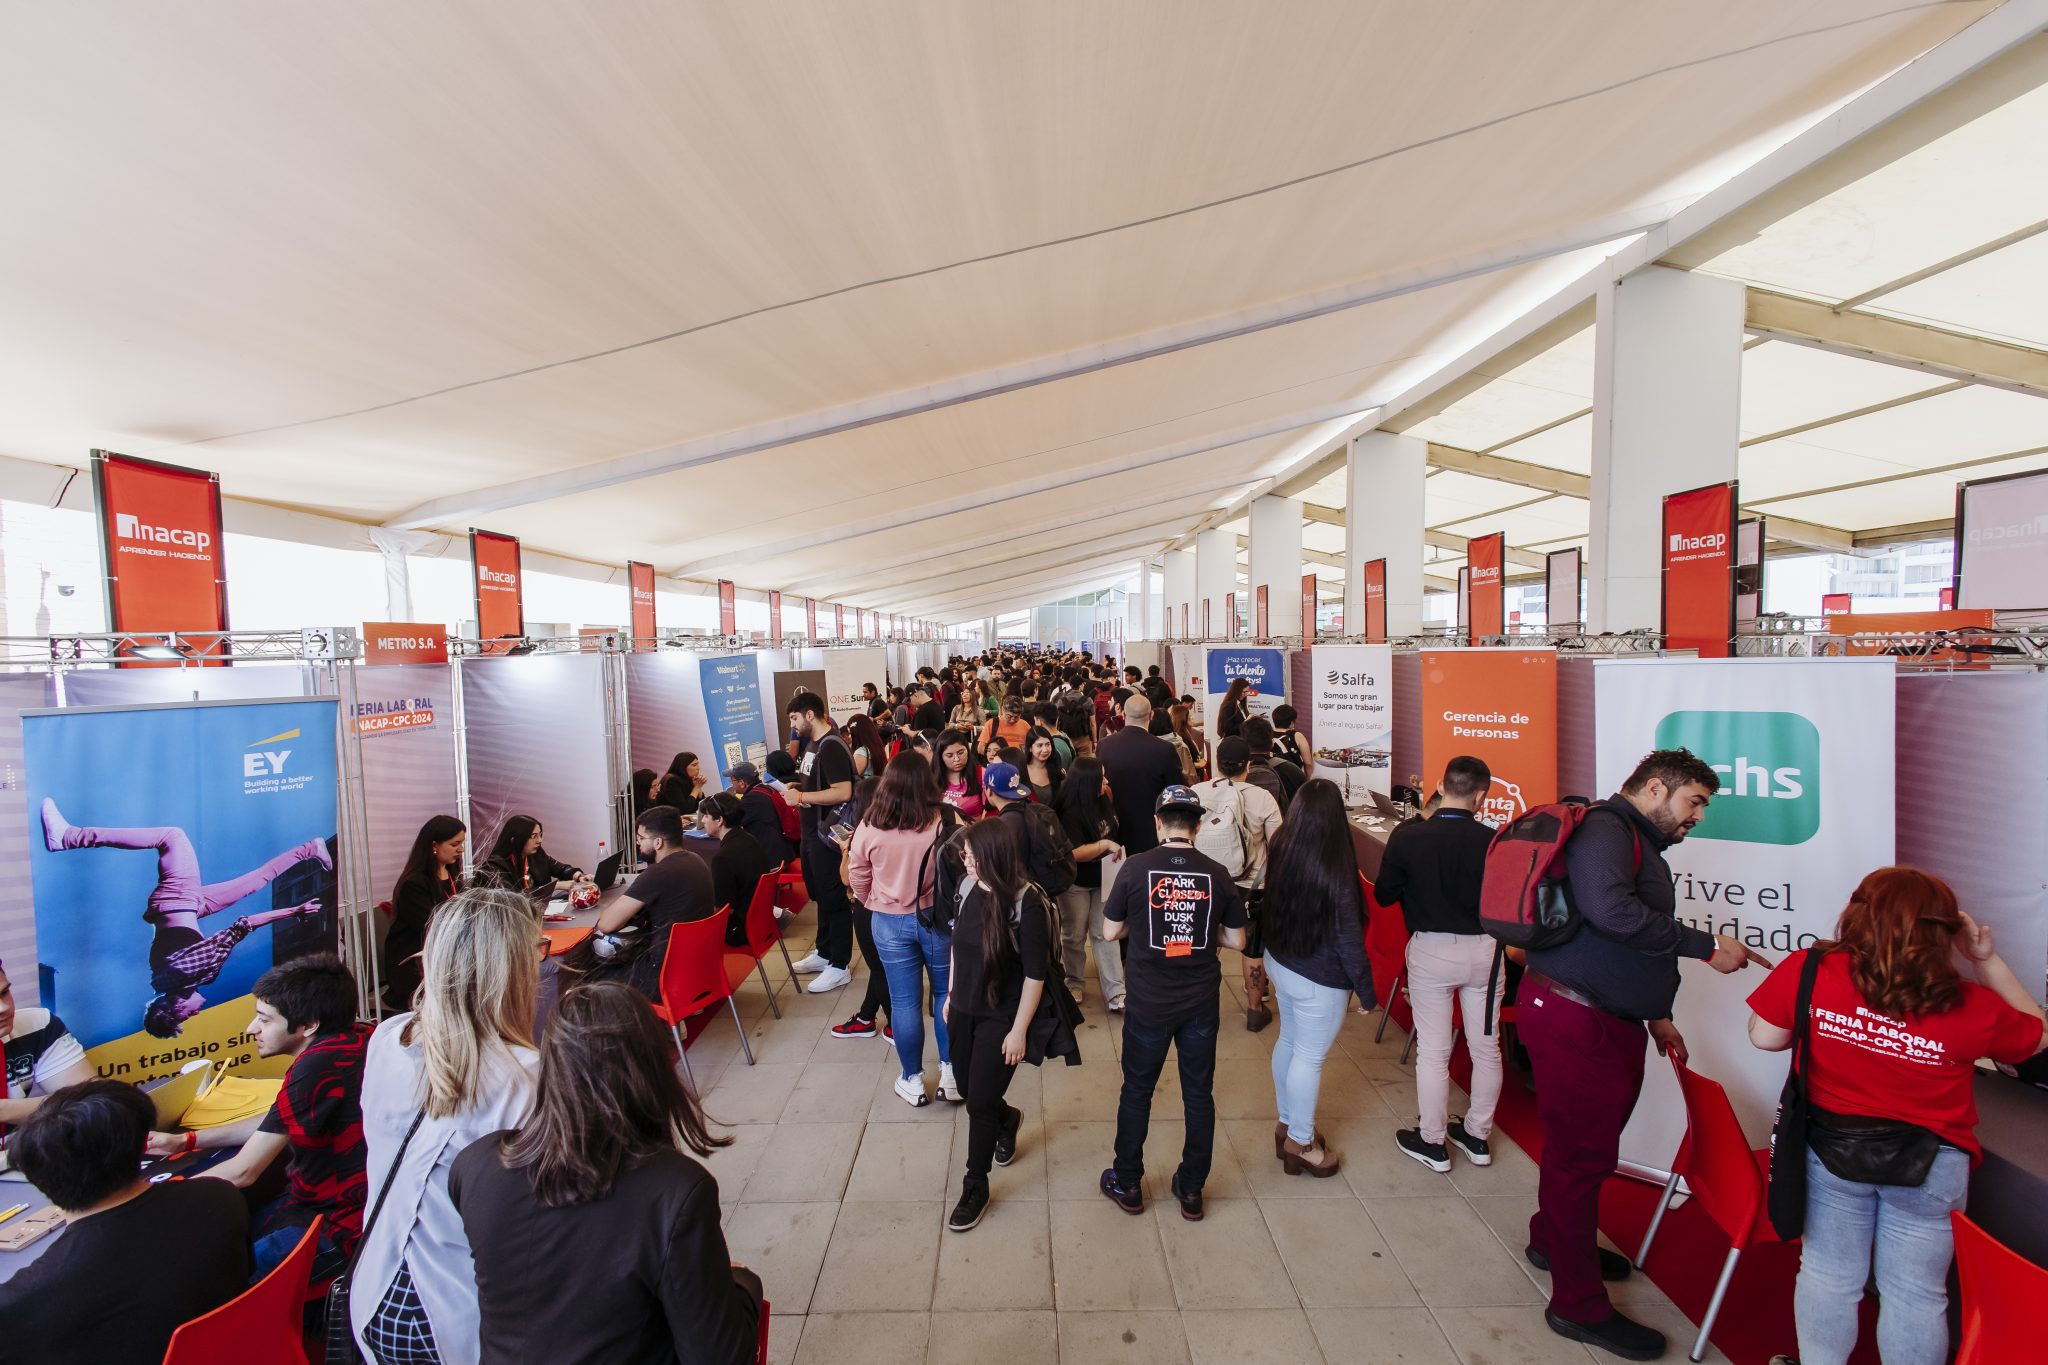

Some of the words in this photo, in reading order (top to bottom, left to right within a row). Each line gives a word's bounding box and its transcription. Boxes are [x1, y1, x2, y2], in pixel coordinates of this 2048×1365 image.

[119, 545, 167, 557] APRENDER
[169, 551, 211, 561] HACIENDO
[1670, 554, 1698, 563] APRENDER
[378, 638, 417, 650] METRO
[419, 637, 437, 649] S.A.
[1852, 631, 1961, 648] CENCOS
[1223, 663, 1235, 676] tu
[1341, 672, 1375, 686] Salfa
[830, 694, 850, 704] ONE
[1323, 691, 1348, 700] Somos
[1360, 694, 1378, 702] gran
[1317, 701, 1336, 711] lugar
[1336, 703, 1353, 712] para
[1354, 703, 1384, 713] trabajar
[358, 715, 411, 731] NACAP-CPC
[412, 712, 432, 723] 2024
[1443, 711, 1507, 723] Gerencia
[1510, 712, 1529, 724] de
[1453, 726, 1520, 739] Personas
[244, 750, 292, 777] EY
[244, 779, 280, 788] Building
[288, 775, 314, 783] better
[1710, 757, 1803, 799] chs
[244, 785, 279, 795] working
[280, 782, 304, 791] world
[1164, 878, 1196, 889] PARK
[1757, 883, 1795, 912] el
[1163, 900, 1196, 912] FROM
[1164, 911, 1194, 923] DUSK
[1163, 934, 1194, 945] DAWN
[1676, 914, 1820, 953] idado
[1815, 1007, 1864, 1030] FERIA
[1867, 1021, 1945, 1053] LABORAL
[1819, 1021, 1903, 1052] INACAP-CPC
[1904, 1046, 1940, 1060] 2024
[98, 1062, 131, 1079] Un
[138, 1041, 220, 1069] trabajo
